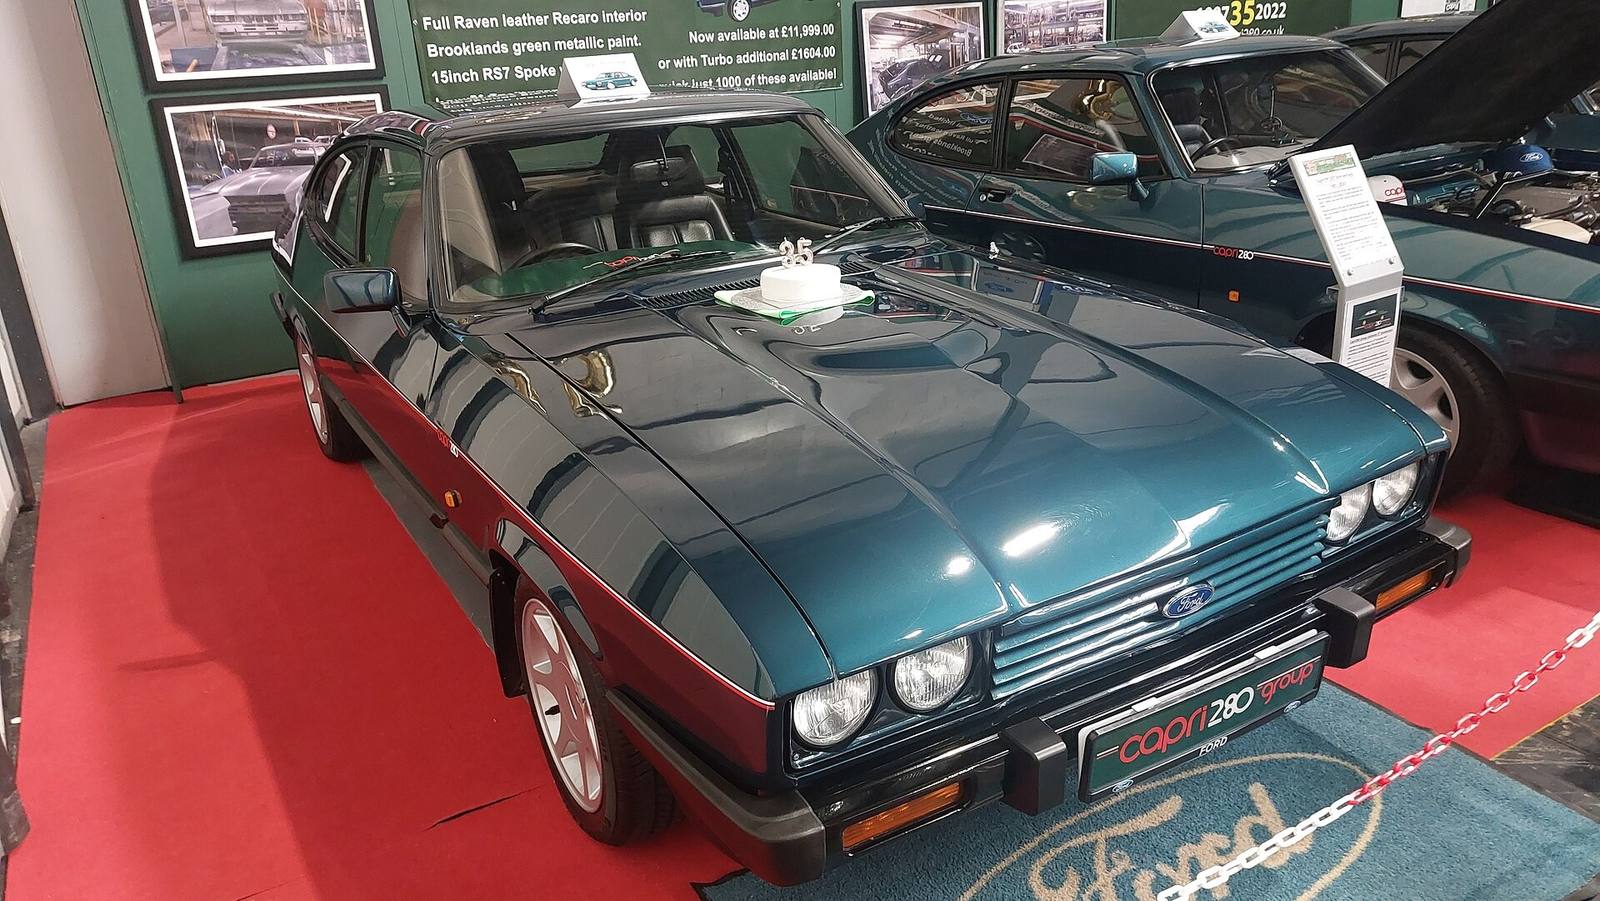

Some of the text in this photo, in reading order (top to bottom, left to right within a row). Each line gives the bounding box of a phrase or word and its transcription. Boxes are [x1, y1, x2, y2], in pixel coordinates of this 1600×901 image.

[422, 16, 450, 31] Full
[453, 14, 499, 30] Raven
[502, 12, 550, 28] leather
[552, 11, 599, 26] Recaro
[1255, 2, 1287, 20] 2022
[689, 23, 835, 44] Now available at £11,999.00
[426, 34, 642, 58] Brooklands green metallic paint.
[658, 46, 836, 70] or with Turbo additional £1604.00
[482, 66, 510, 82] RS7
[514, 64, 557, 80] Spoke
[716, 76, 742, 88] 1000
[744, 74, 756, 87] of
[756, 72, 787, 85] these
[788, 67, 838, 84] available!
[779, 236, 814, 269] 35
[1260, 661, 1315, 705] group
[1198, 735, 1229, 757] FORD
